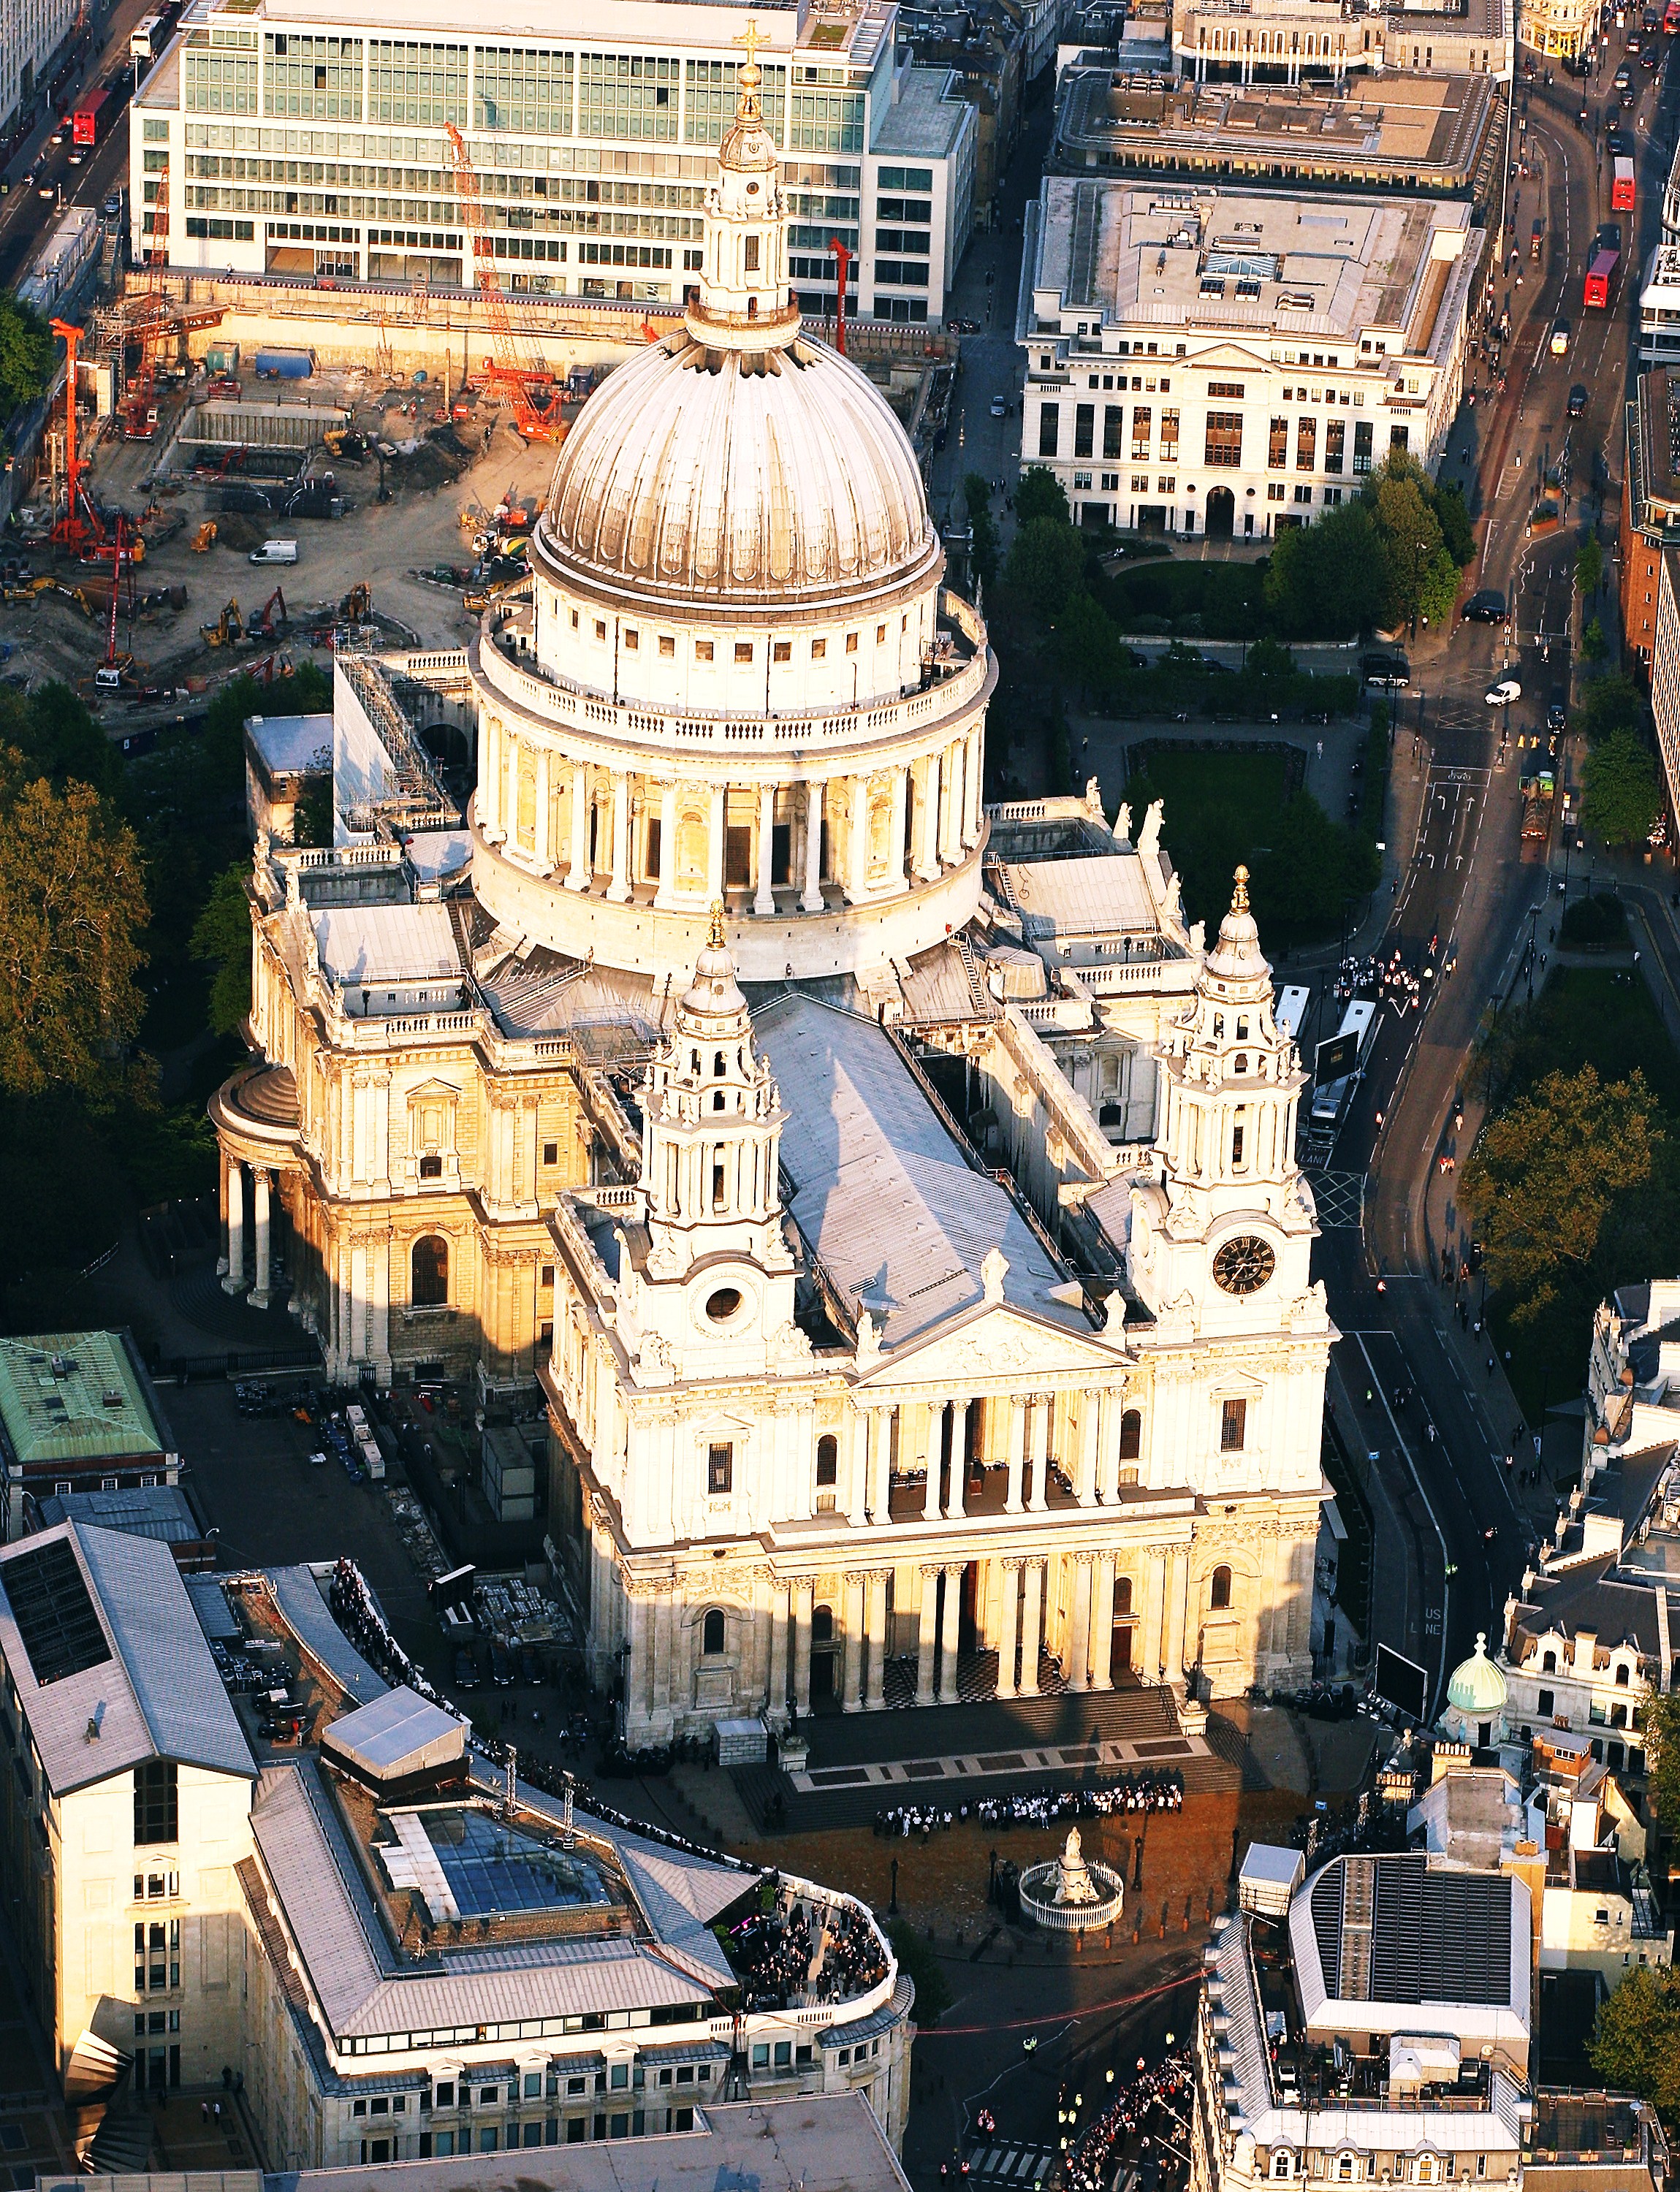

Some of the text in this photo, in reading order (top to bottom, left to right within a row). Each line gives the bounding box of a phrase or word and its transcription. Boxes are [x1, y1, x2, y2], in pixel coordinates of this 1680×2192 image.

[1300, 1154, 1326, 1164] LANE
[1425, 1607, 1442, 1620] US
[1410, 1621, 1442, 1635] LNE
